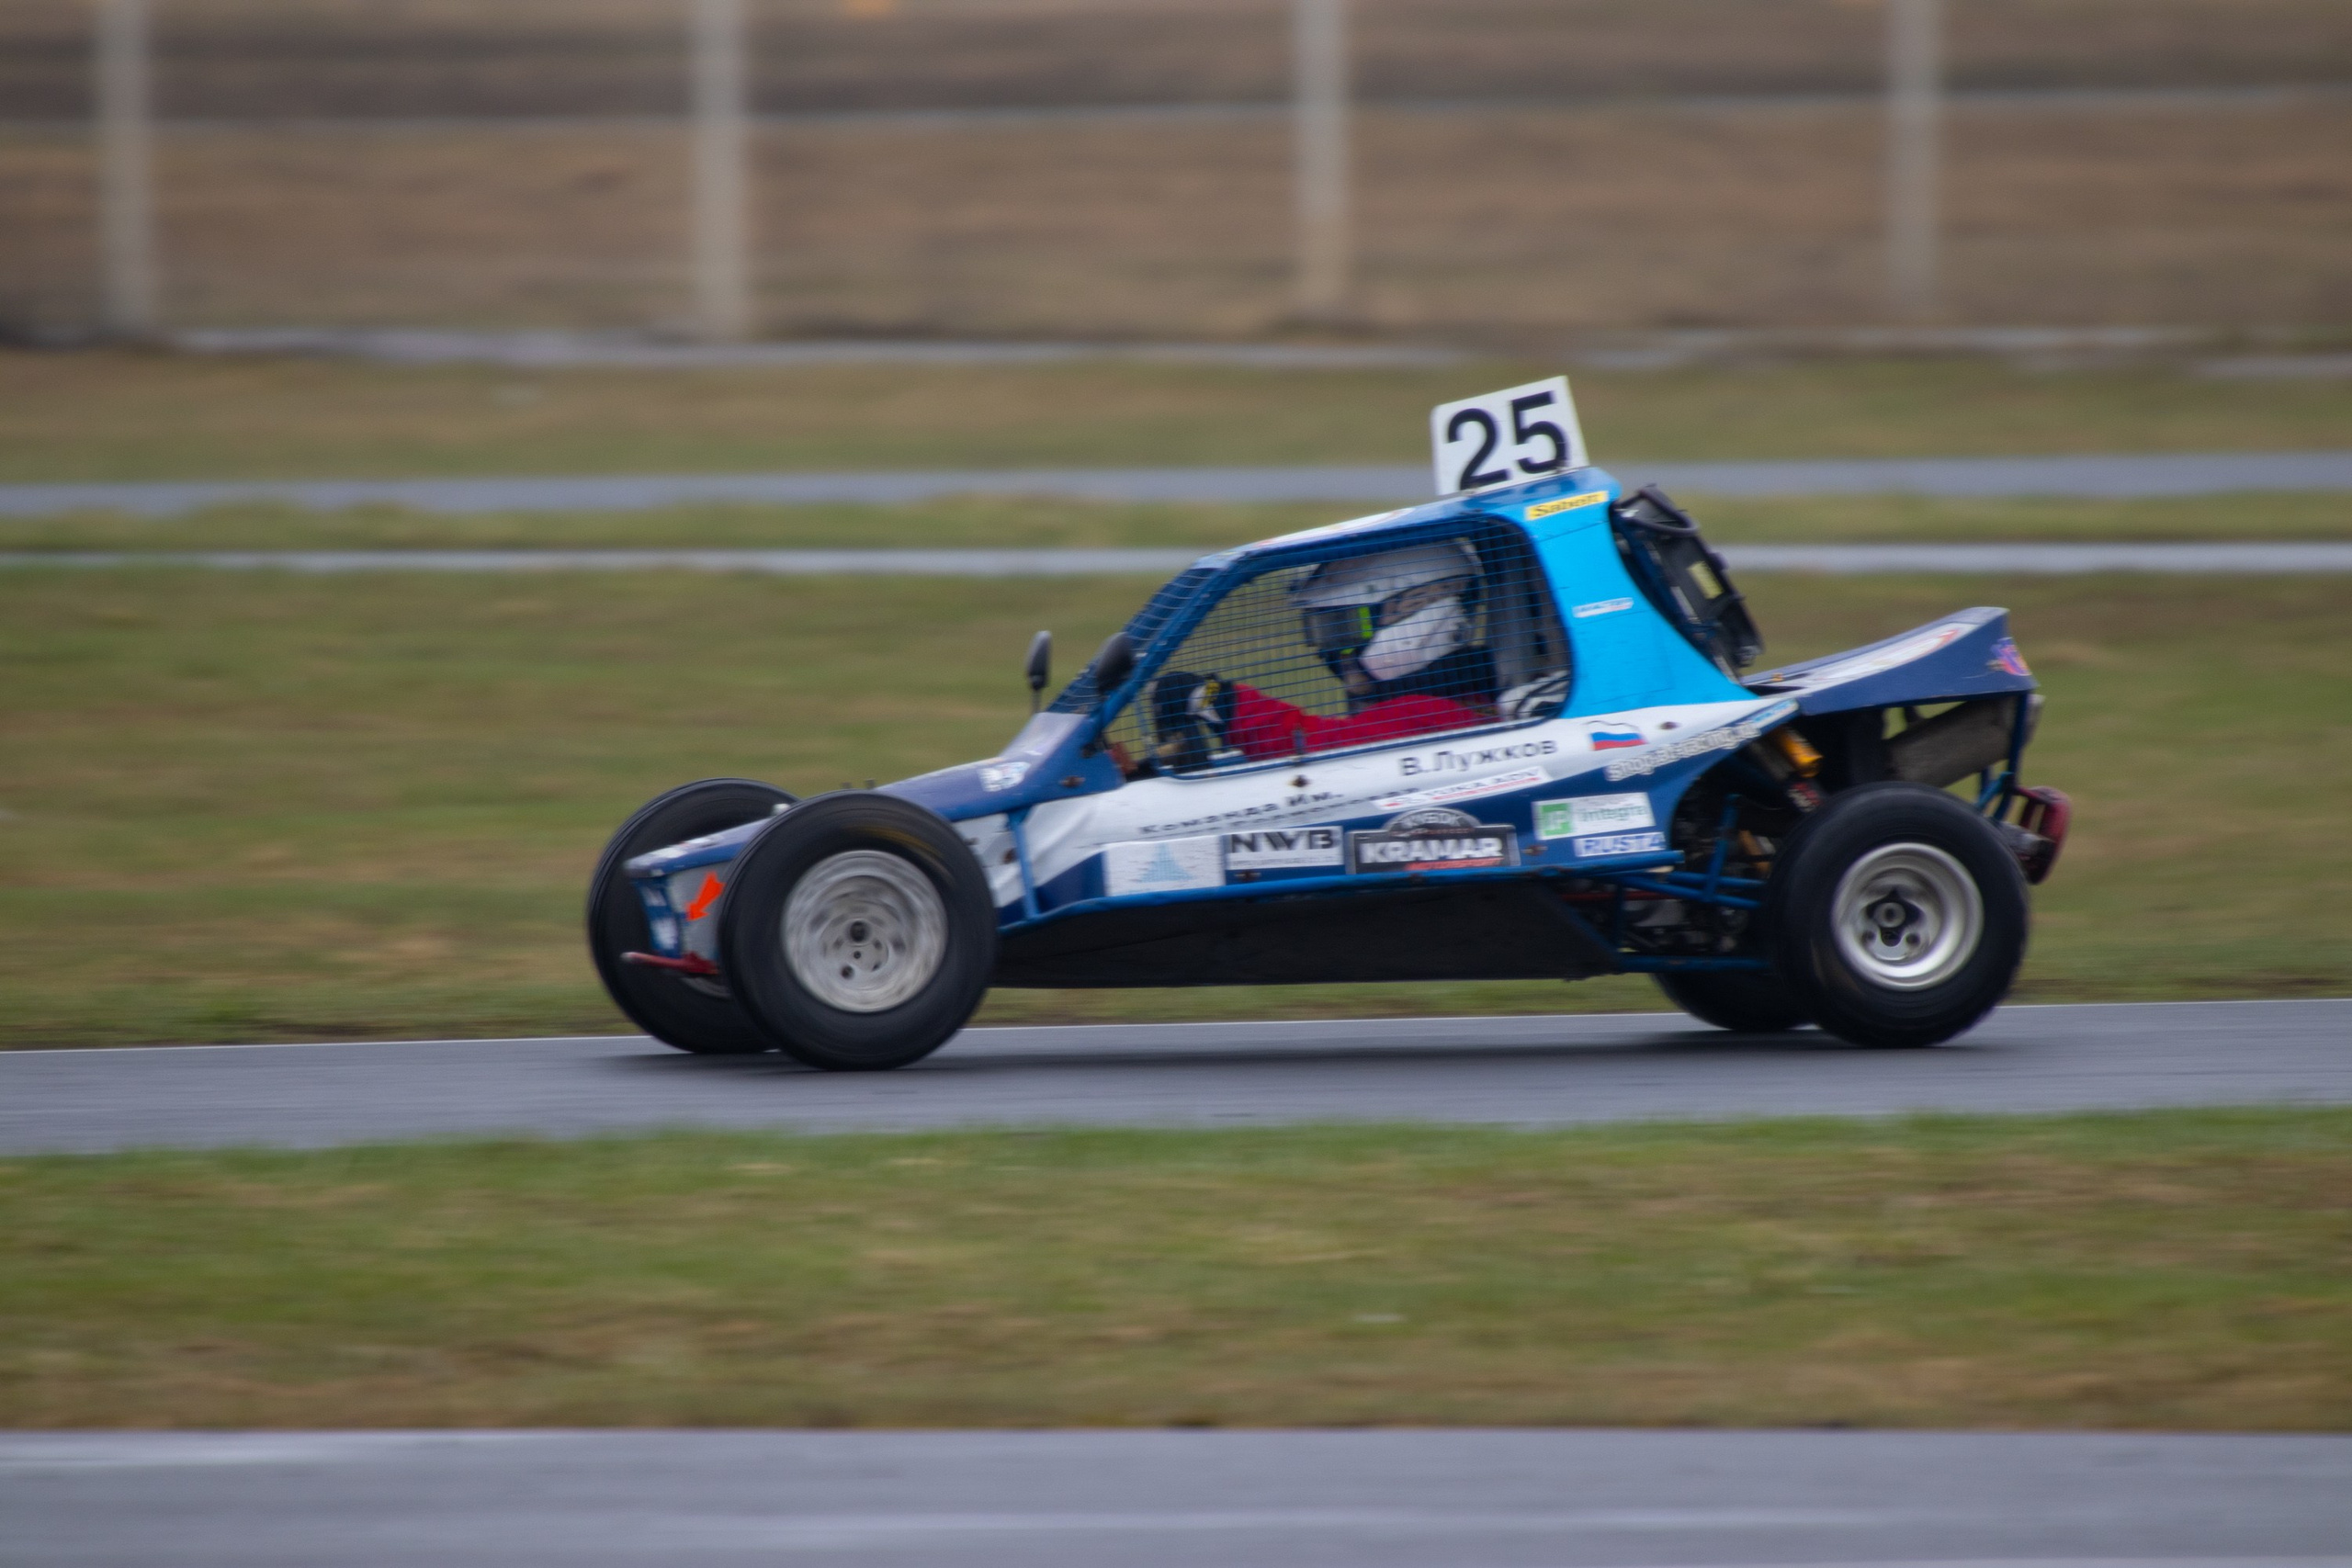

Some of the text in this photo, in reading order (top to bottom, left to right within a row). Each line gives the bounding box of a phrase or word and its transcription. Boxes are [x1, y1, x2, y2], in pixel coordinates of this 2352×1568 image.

[1447, 389, 1567, 491] 25
[1400, 739, 1557, 776] В.Лужков
[1230, 829, 1333, 852] NWB
[1359, 837, 1504, 863] KRAMAR
